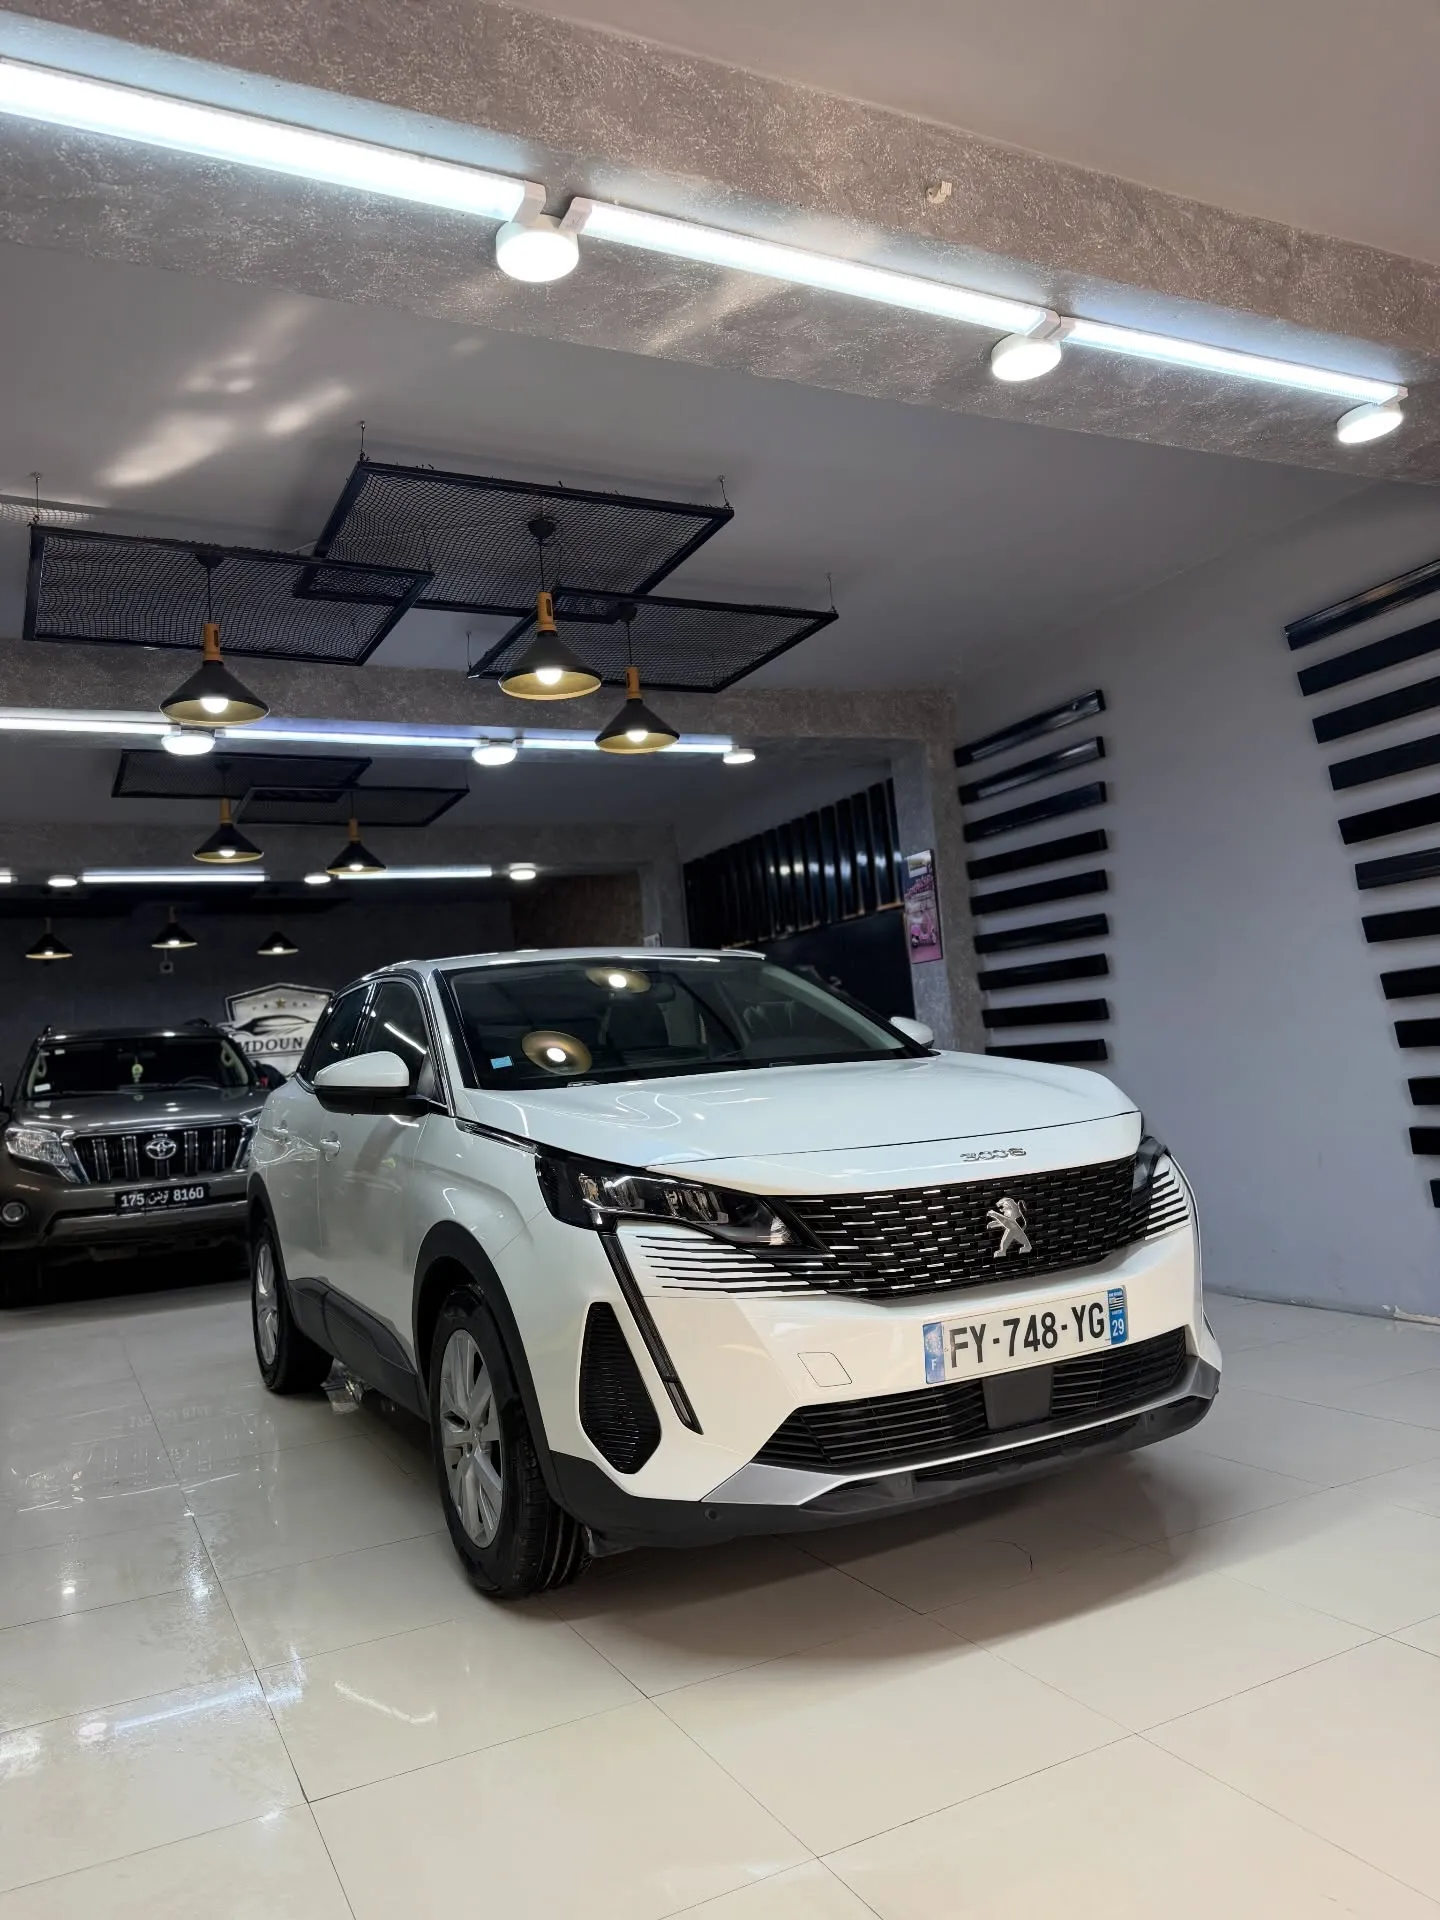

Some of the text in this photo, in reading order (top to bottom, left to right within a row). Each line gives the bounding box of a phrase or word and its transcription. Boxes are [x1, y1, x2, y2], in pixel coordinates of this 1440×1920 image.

[120, 1193, 145, 1208] 175
[173, 1186, 205, 1202] 8160
[949, 1302, 1105, 1369] FY-748-YG
[1111, 1318, 1125, 1337] 29
[931, 1358, 938, 1371] F
